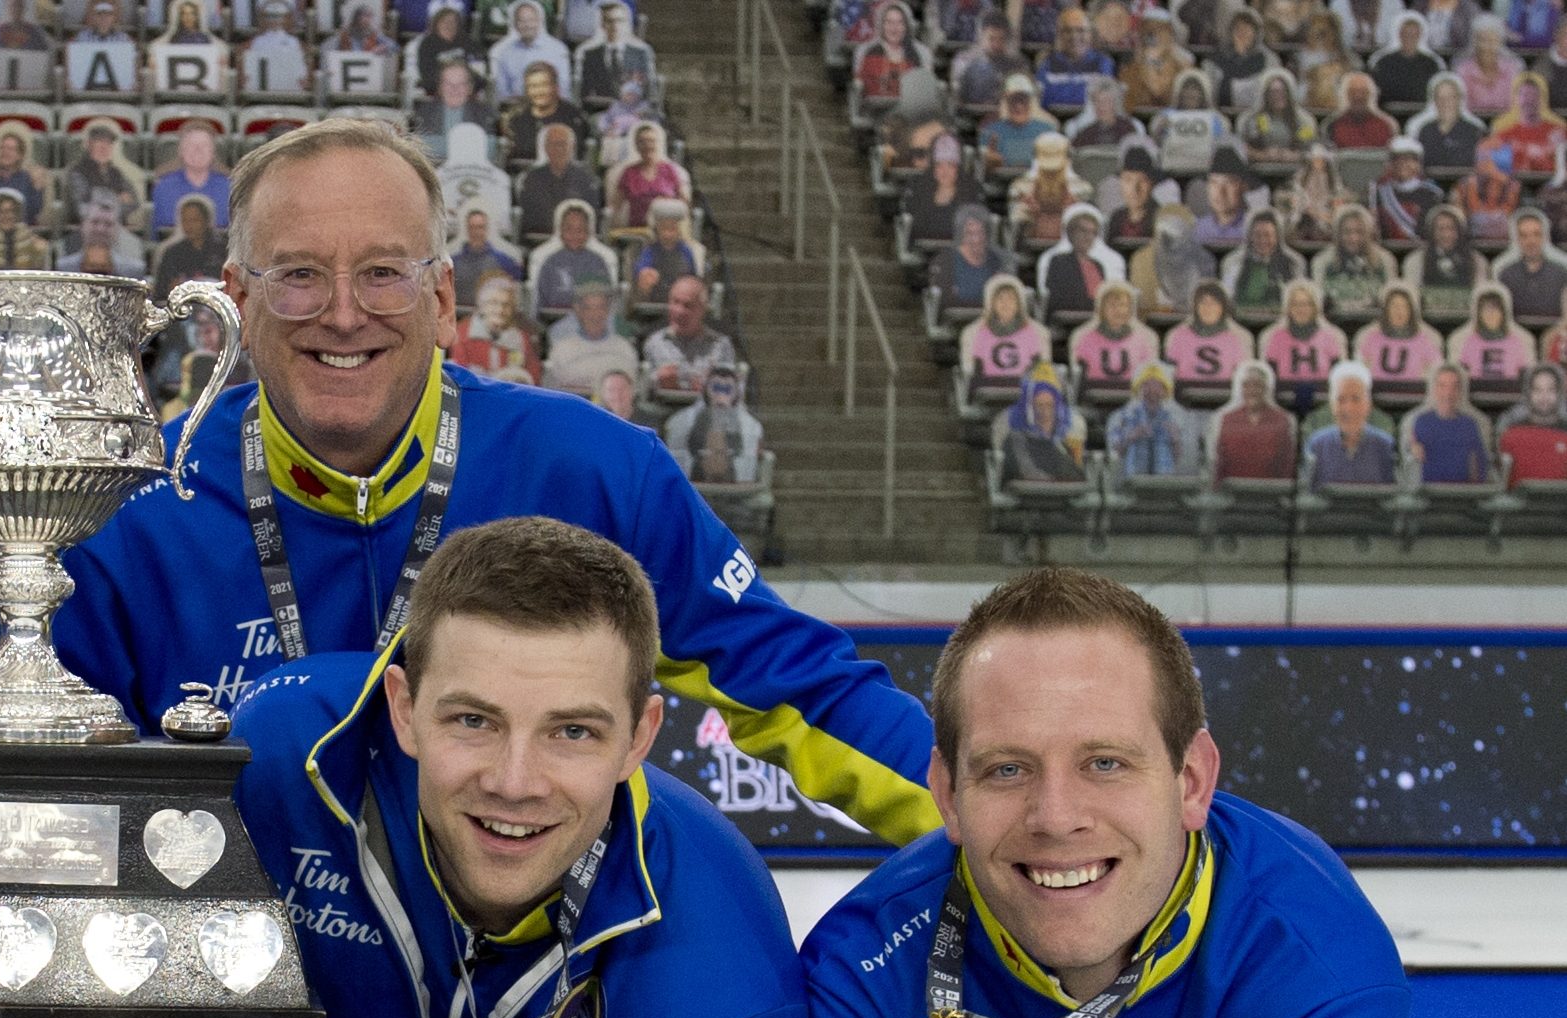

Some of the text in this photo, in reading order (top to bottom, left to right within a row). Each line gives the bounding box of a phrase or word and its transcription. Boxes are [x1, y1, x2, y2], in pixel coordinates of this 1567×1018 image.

[440, 382, 458, 398] 2021
[438, 411, 450, 447] CURLING
[447, 416, 459, 450] CANADA
[244, 437, 256, 473] CANADA
[253, 435, 265, 472] CURLING
[249, 495, 273, 511] 2021
[427, 481, 449, 497] 2021
[269, 581, 292, 596] 2021
[403, 566, 421, 582] 202
[385, 594, 406, 632] CURLING
[279, 623, 297, 660] CANADA
[288, 622, 307, 659] CURLING
[290, 846, 351, 896] Tim
[563, 894, 580, 919] 2021
[945, 901, 966, 923] 2021
[859, 907, 932, 973] DYNASTY
[933, 969, 959, 985] 2021
[1114, 973, 1139, 986] 2021
